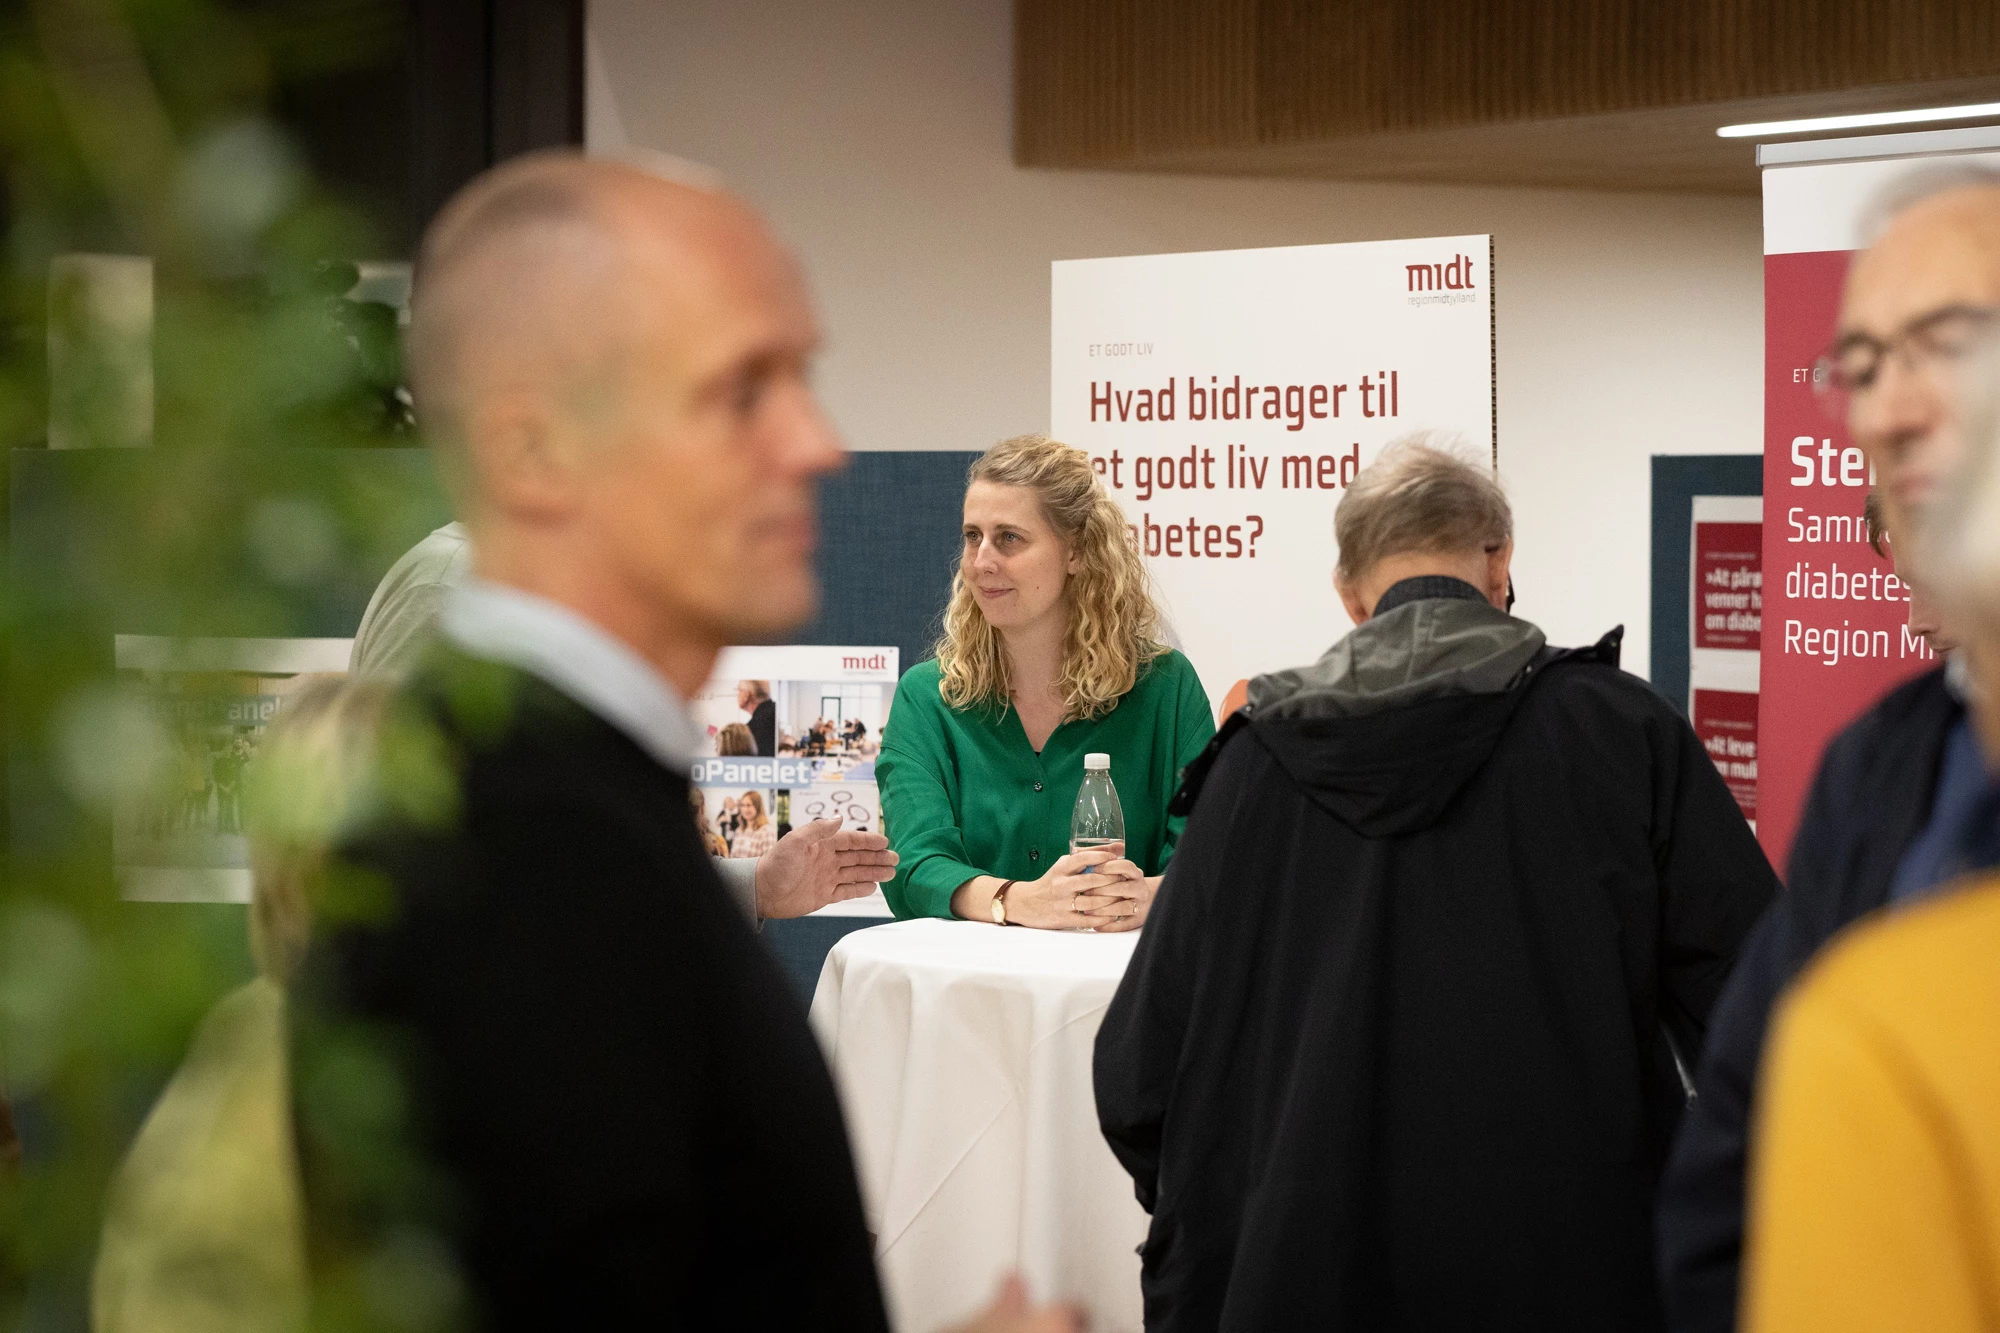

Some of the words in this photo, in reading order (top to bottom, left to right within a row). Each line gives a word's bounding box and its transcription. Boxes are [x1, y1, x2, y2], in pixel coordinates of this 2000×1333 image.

[1405, 253, 1475, 291] midt
[1407, 293, 1476, 308] regionmidtjylland
[1089, 344, 1102, 357] ET
[1105, 343, 1133, 357] GODT
[1137, 342, 1154, 356] LIV
[1793, 368, 1809, 382] ET
[1090, 377, 1175, 422] Hvad
[1189, 375, 1347, 431] bidrager
[1359, 371, 1398, 418] til
[1135, 445, 1216, 501] godt
[1228, 444, 1269, 489] liv
[1282, 443, 1360, 490] med
[1791, 436, 1877, 487] Ste
[1785, 562, 1912, 602] diabetes
[842, 654, 887, 670] midt
[1784, 619, 1889, 666] Region
